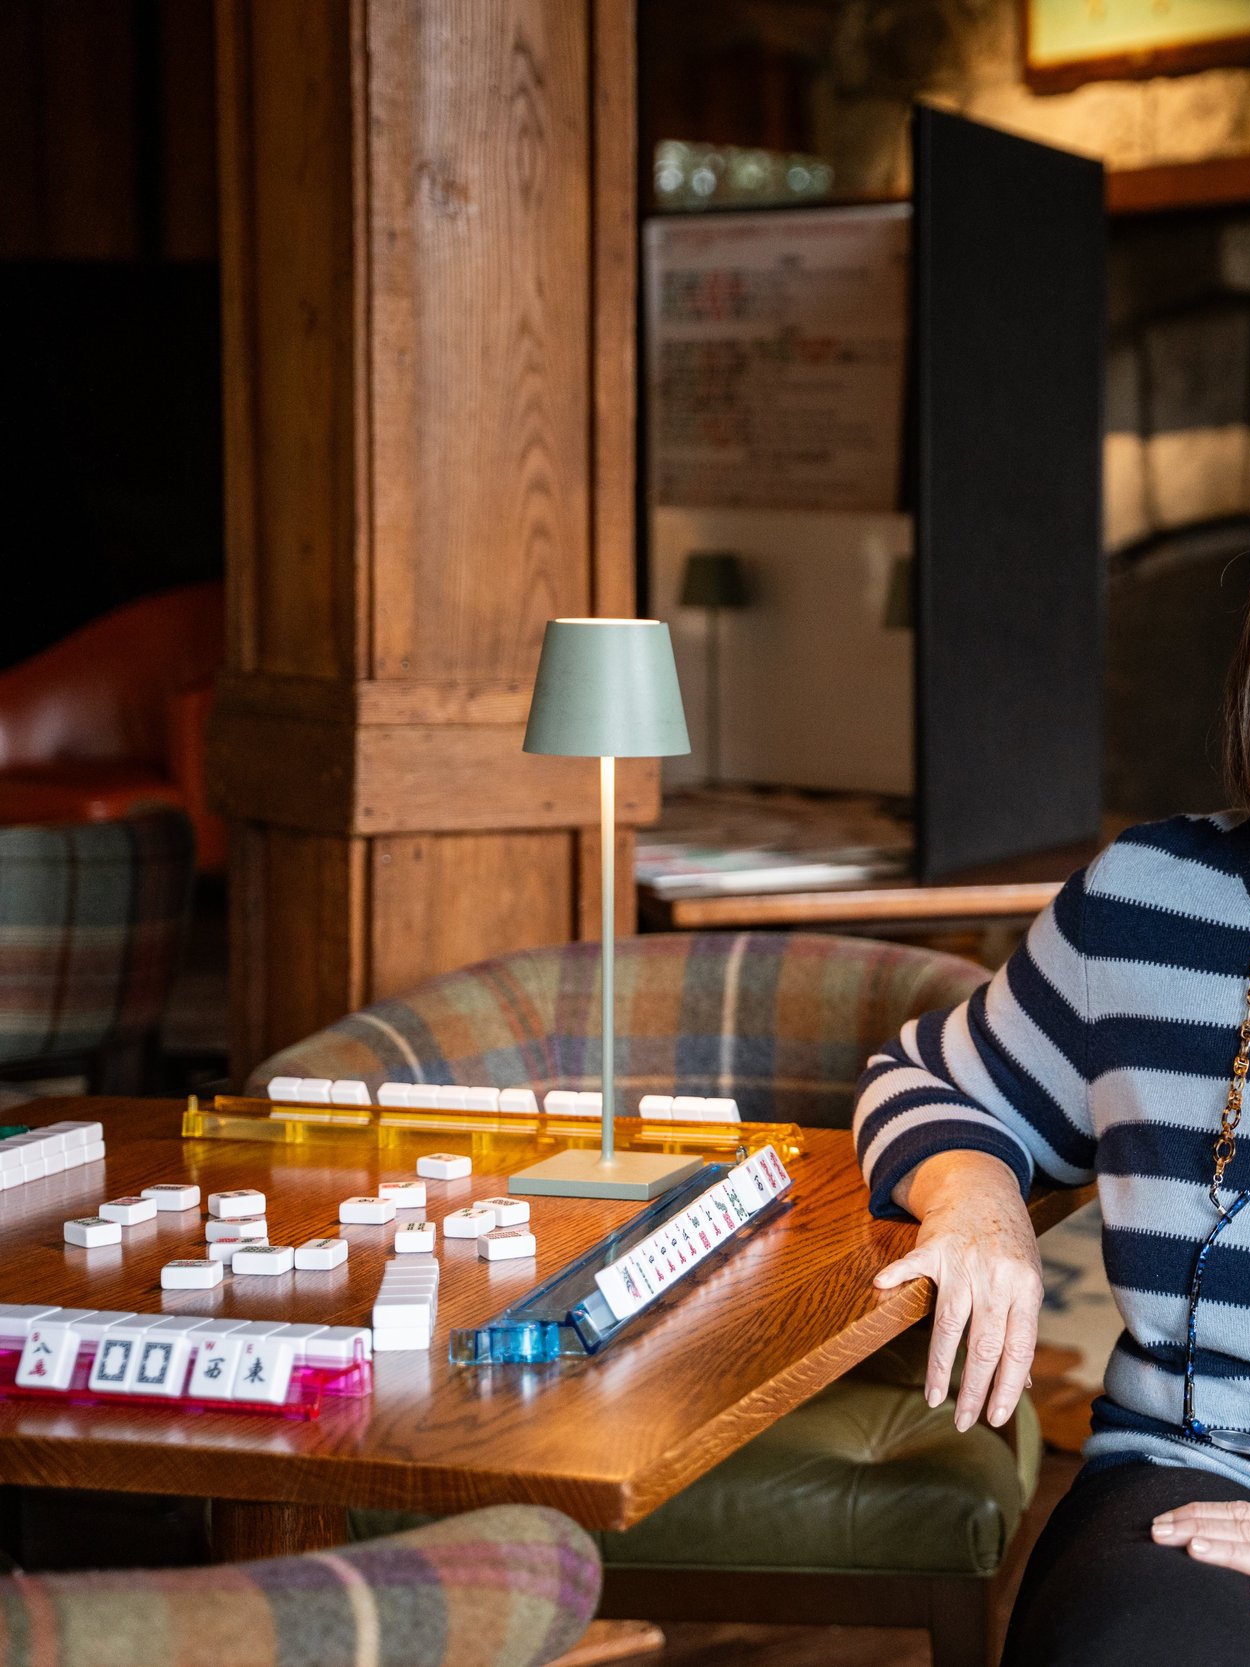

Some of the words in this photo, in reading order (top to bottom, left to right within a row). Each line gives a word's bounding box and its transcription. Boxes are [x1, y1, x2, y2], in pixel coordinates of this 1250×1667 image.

[205, 1341, 216, 1351] W
[246, 1344, 254, 1354] E
[244, 1357, 265, 1383] 東
